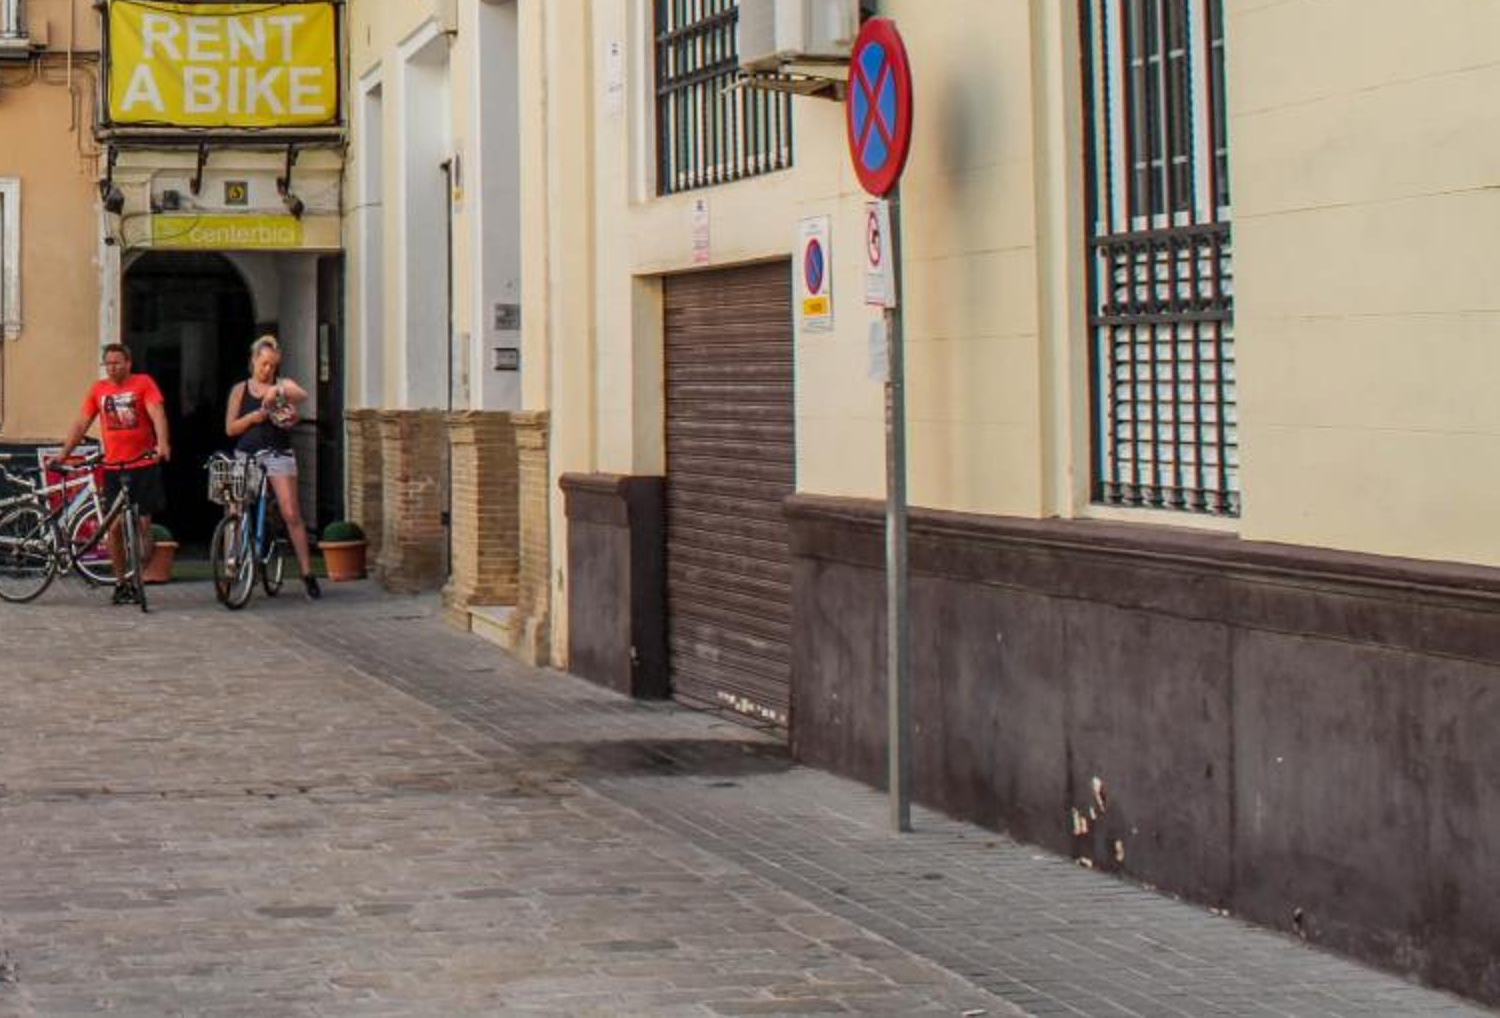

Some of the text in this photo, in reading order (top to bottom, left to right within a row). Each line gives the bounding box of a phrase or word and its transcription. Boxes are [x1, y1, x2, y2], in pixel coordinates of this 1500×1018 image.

[141, 12, 305, 61] RENT
[121, 63, 325, 115] A BIKE
